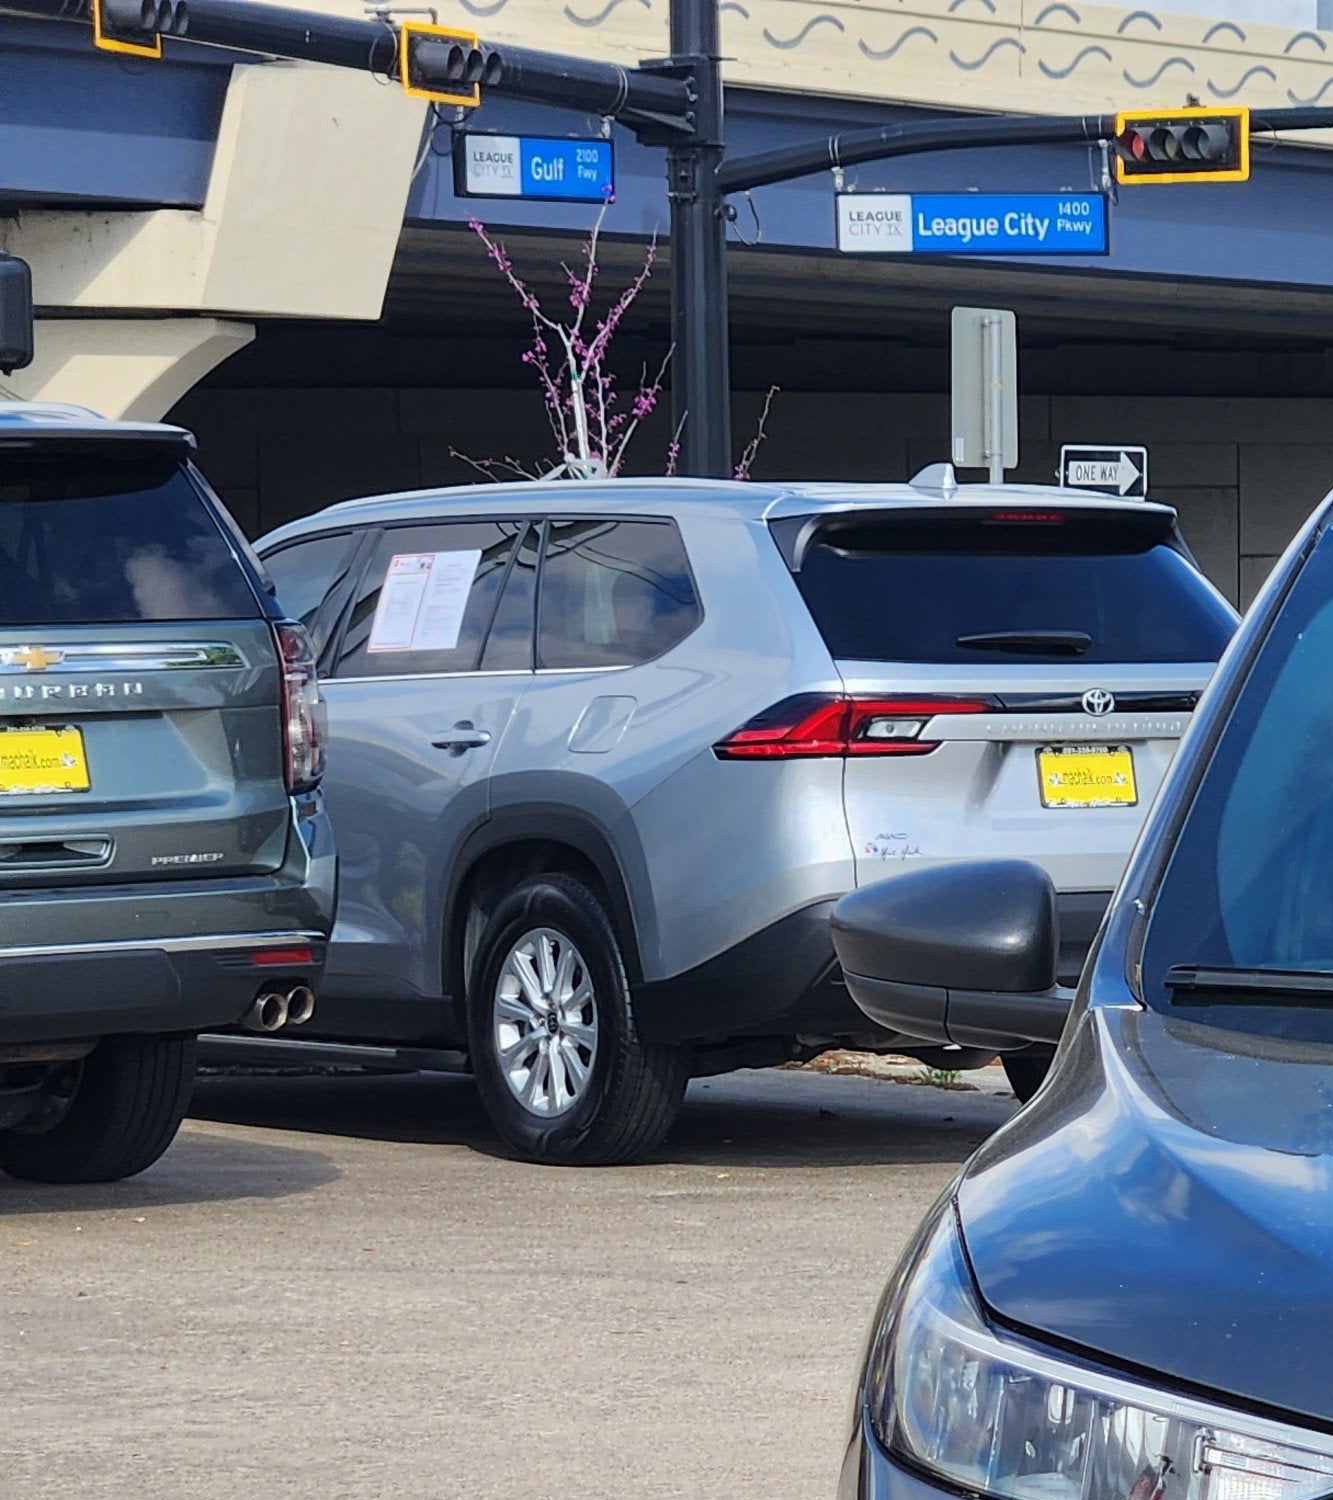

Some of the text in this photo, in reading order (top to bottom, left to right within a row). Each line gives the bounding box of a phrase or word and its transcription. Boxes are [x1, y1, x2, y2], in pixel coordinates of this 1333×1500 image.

[473, 151, 514, 164] LEAGUE
[576, 149, 599, 163] 2100
[531, 156, 565, 181] Gulf
[577, 165, 597, 182] Fwy
[849, 210, 902, 222] LEAGUE
[1058, 202, 1089, 216] 1400
[849, 223, 883, 236] CITY
[918, 212, 1049, 243] League City
[1057, 219, 1092, 235] Pkwy
[1076, 465, 1118, 481] ONE WAY
[0, 682, 143, 699] URBAN
[151, 852, 224, 865] PREMIER
